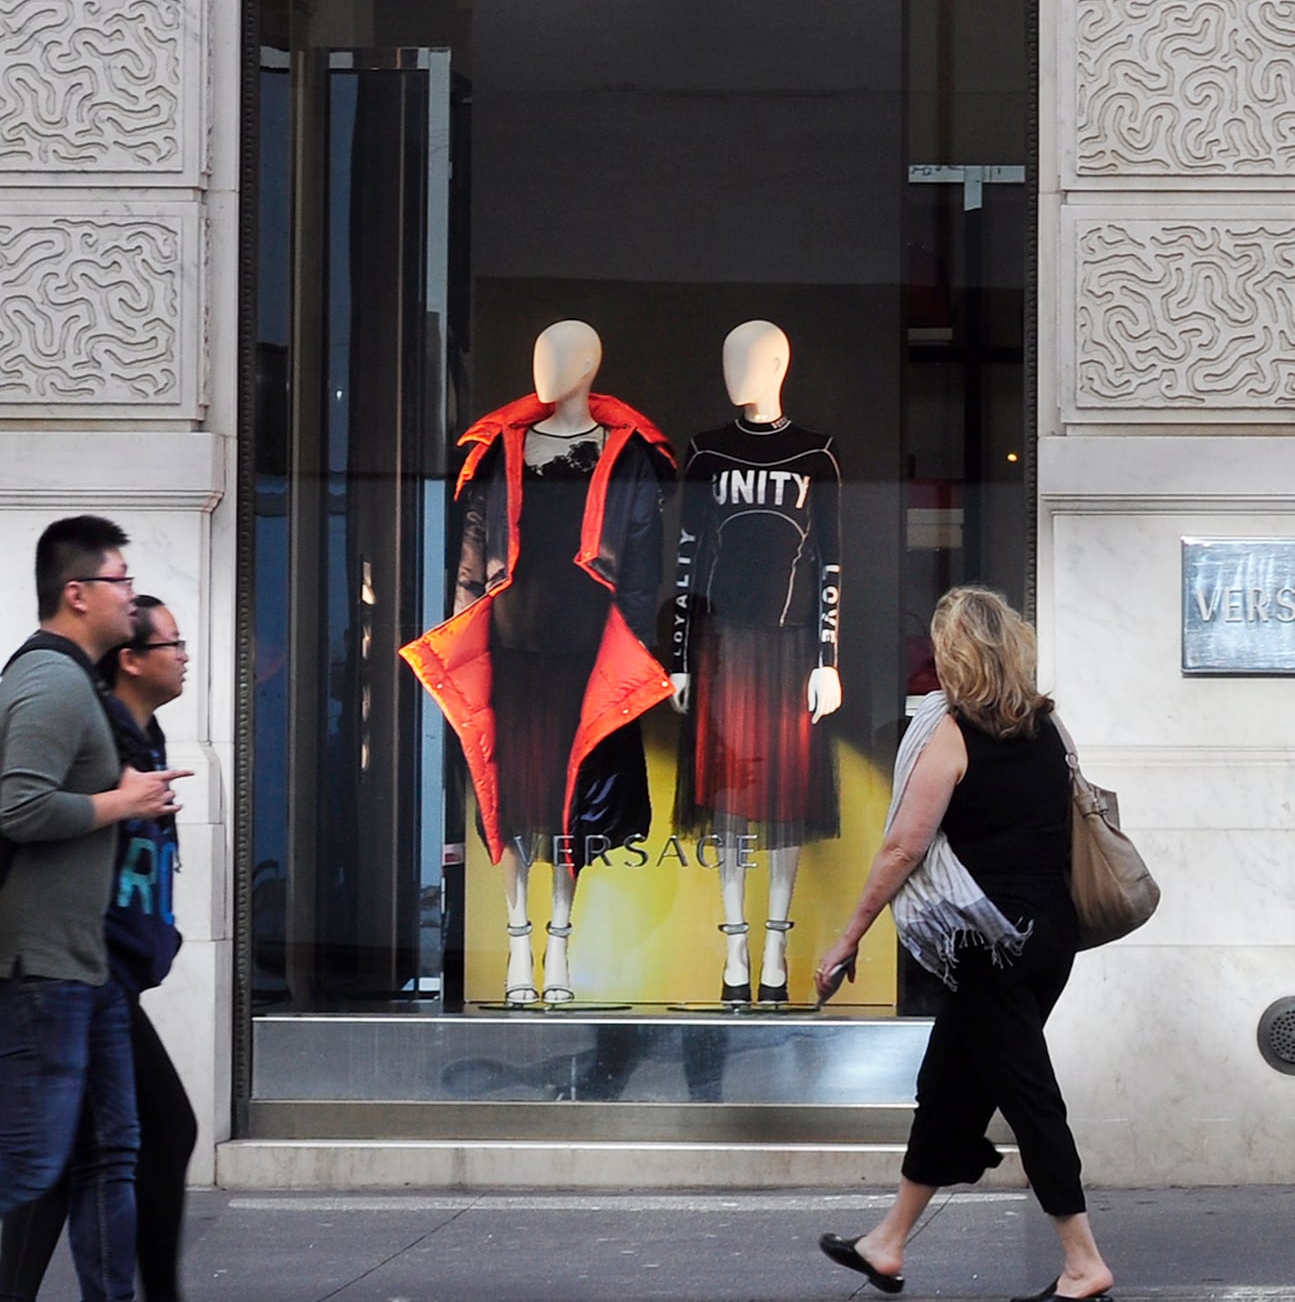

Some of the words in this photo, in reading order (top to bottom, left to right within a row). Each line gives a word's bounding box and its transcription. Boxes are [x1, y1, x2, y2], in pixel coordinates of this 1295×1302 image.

[711, 469, 811, 509] UNITY
[821, 564, 841, 643] LOVE
[512, 834, 758, 867] VERSACE
